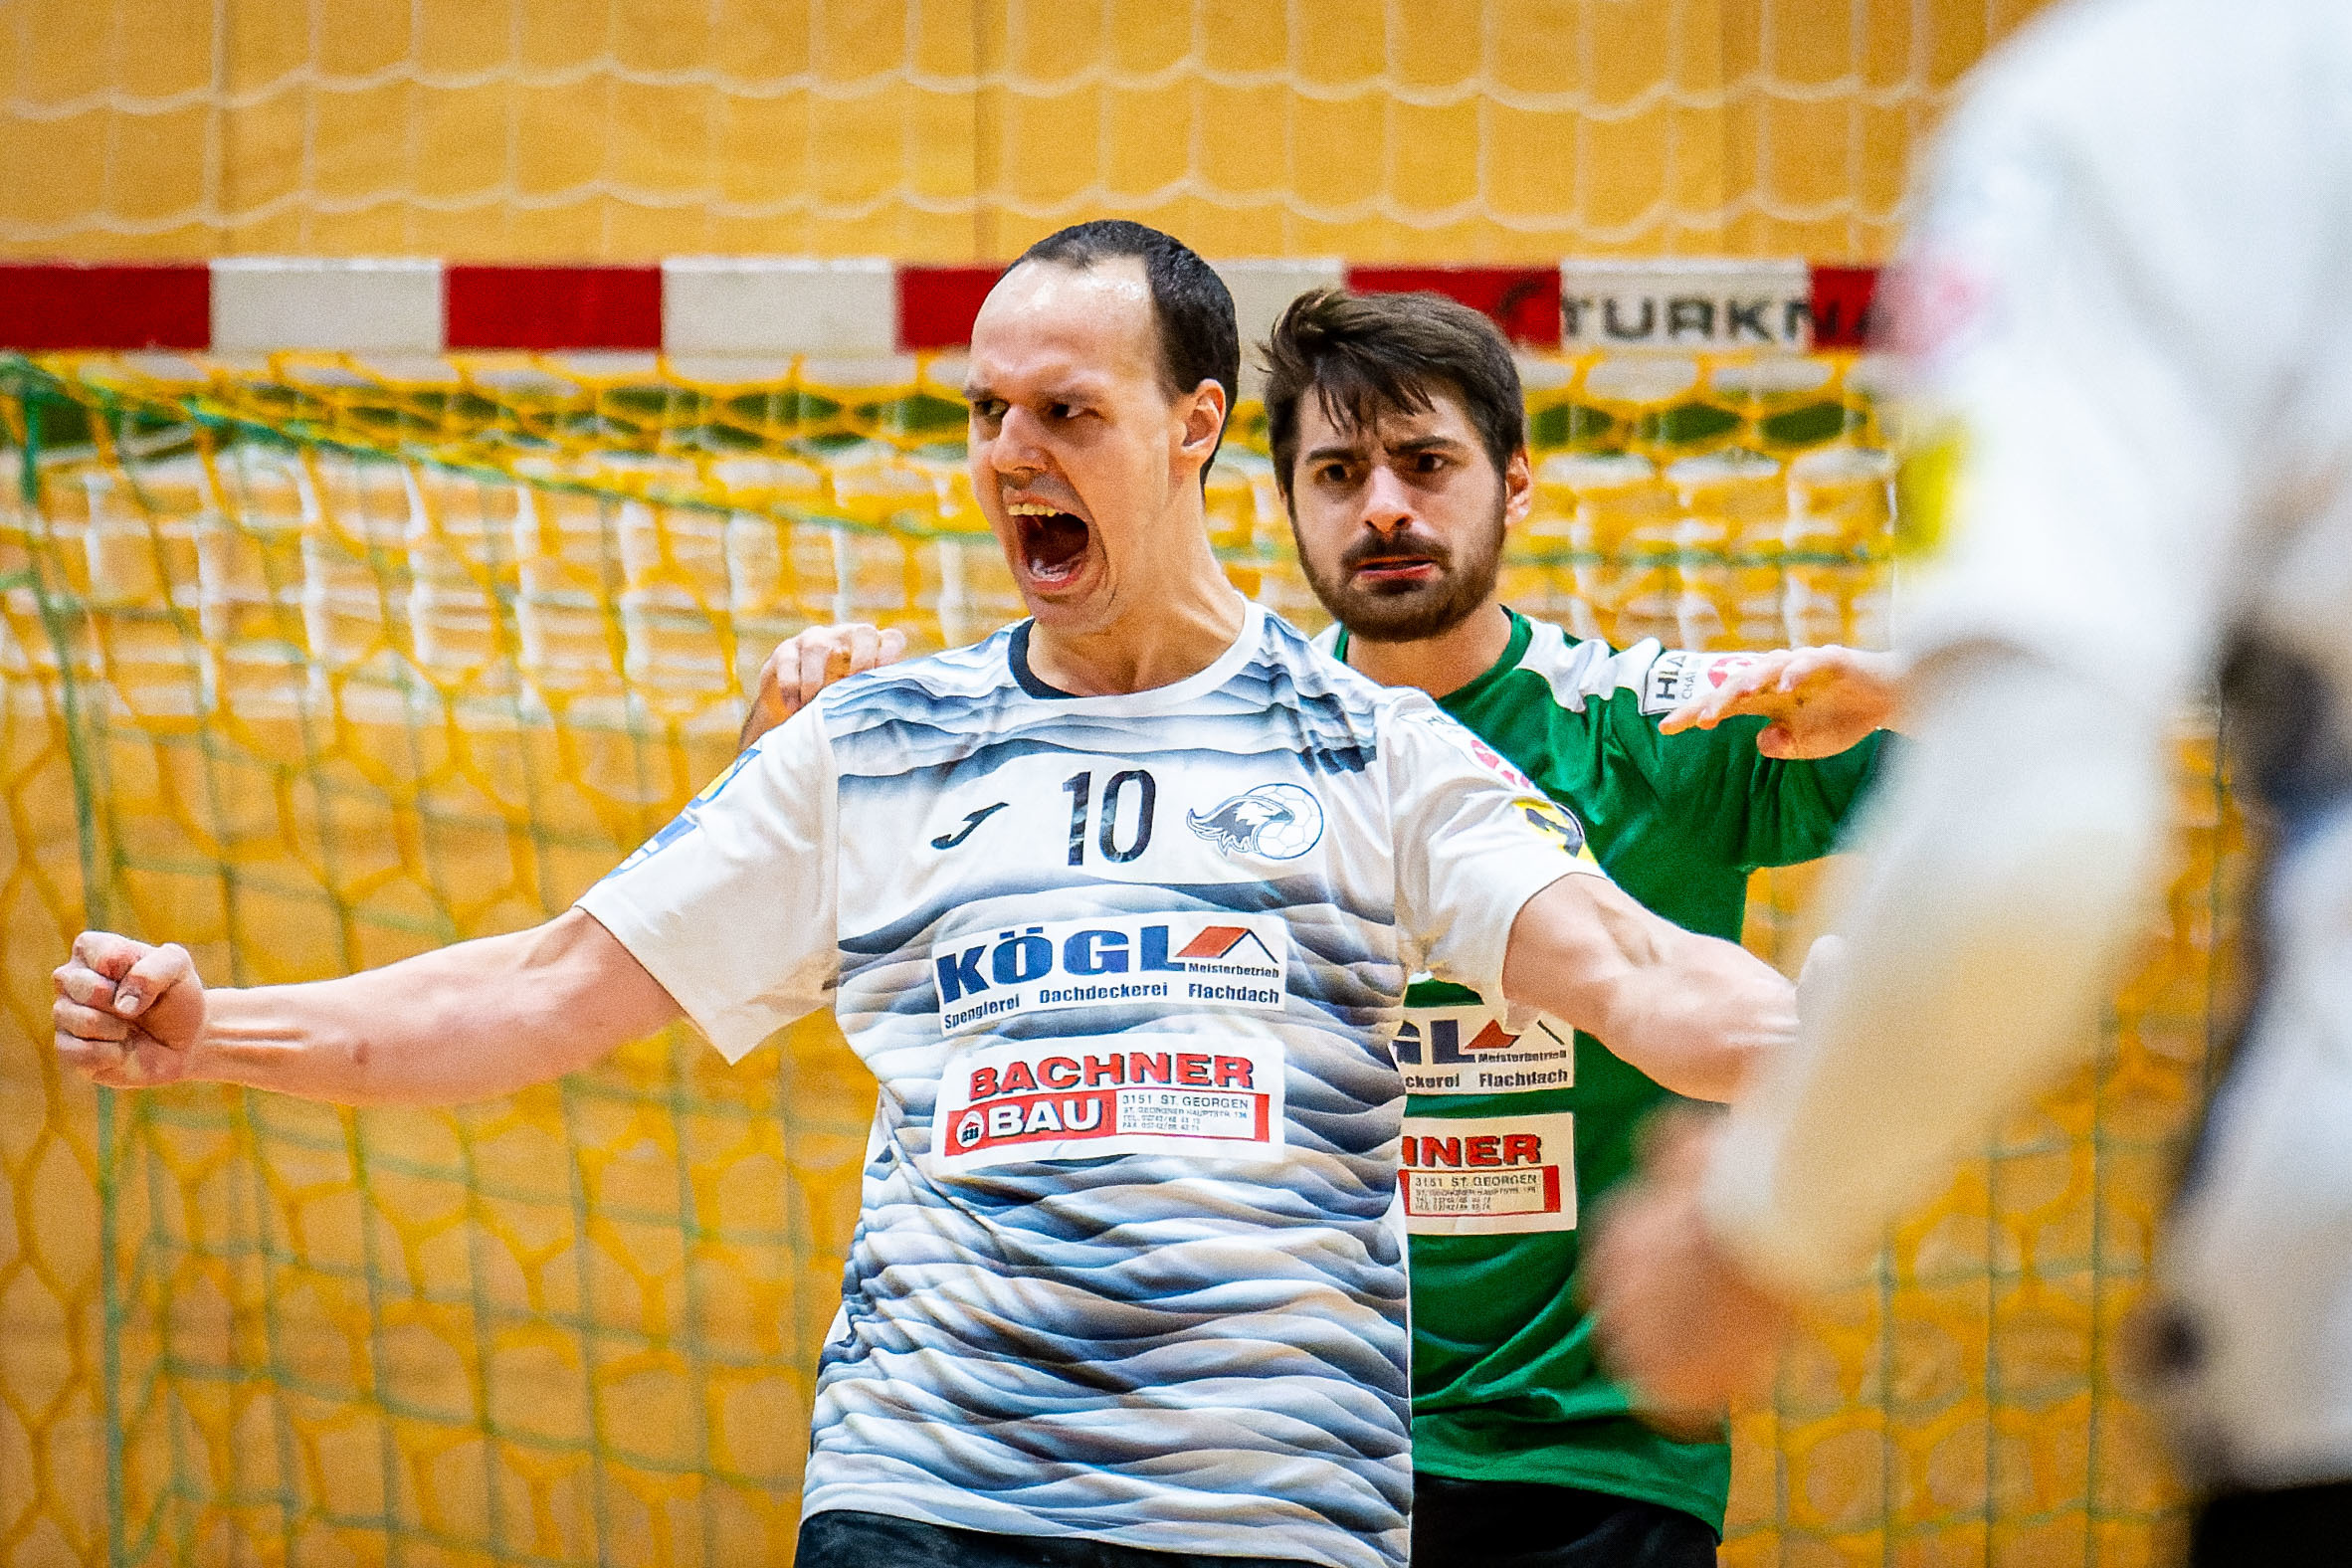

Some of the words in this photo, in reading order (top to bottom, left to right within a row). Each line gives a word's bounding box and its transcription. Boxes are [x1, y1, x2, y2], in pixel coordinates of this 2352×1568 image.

[1561, 296, 1872, 342] TURKN
[1063, 769, 1156, 866] 10
[936, 925, 1185, 1004] KÖGL
[1189, 963, 1279, 978] Meisterbetrieb
[944, 994, 1021, 1030] Spenglerei
[1040, 981, 1168, 1004] Dachdeckerei
[1189, 983, 1279, 1004] Flachdach
[969, 1052, 1254, 1101] BACHNER
[1478, 1069, 1568, 1088] Flachdach
[987, 1094, 1103, 1138] BAU
[1122, 1094, 1152, 1104] 3151
[1182, 1096, 1249, 1109] GEORGEN
